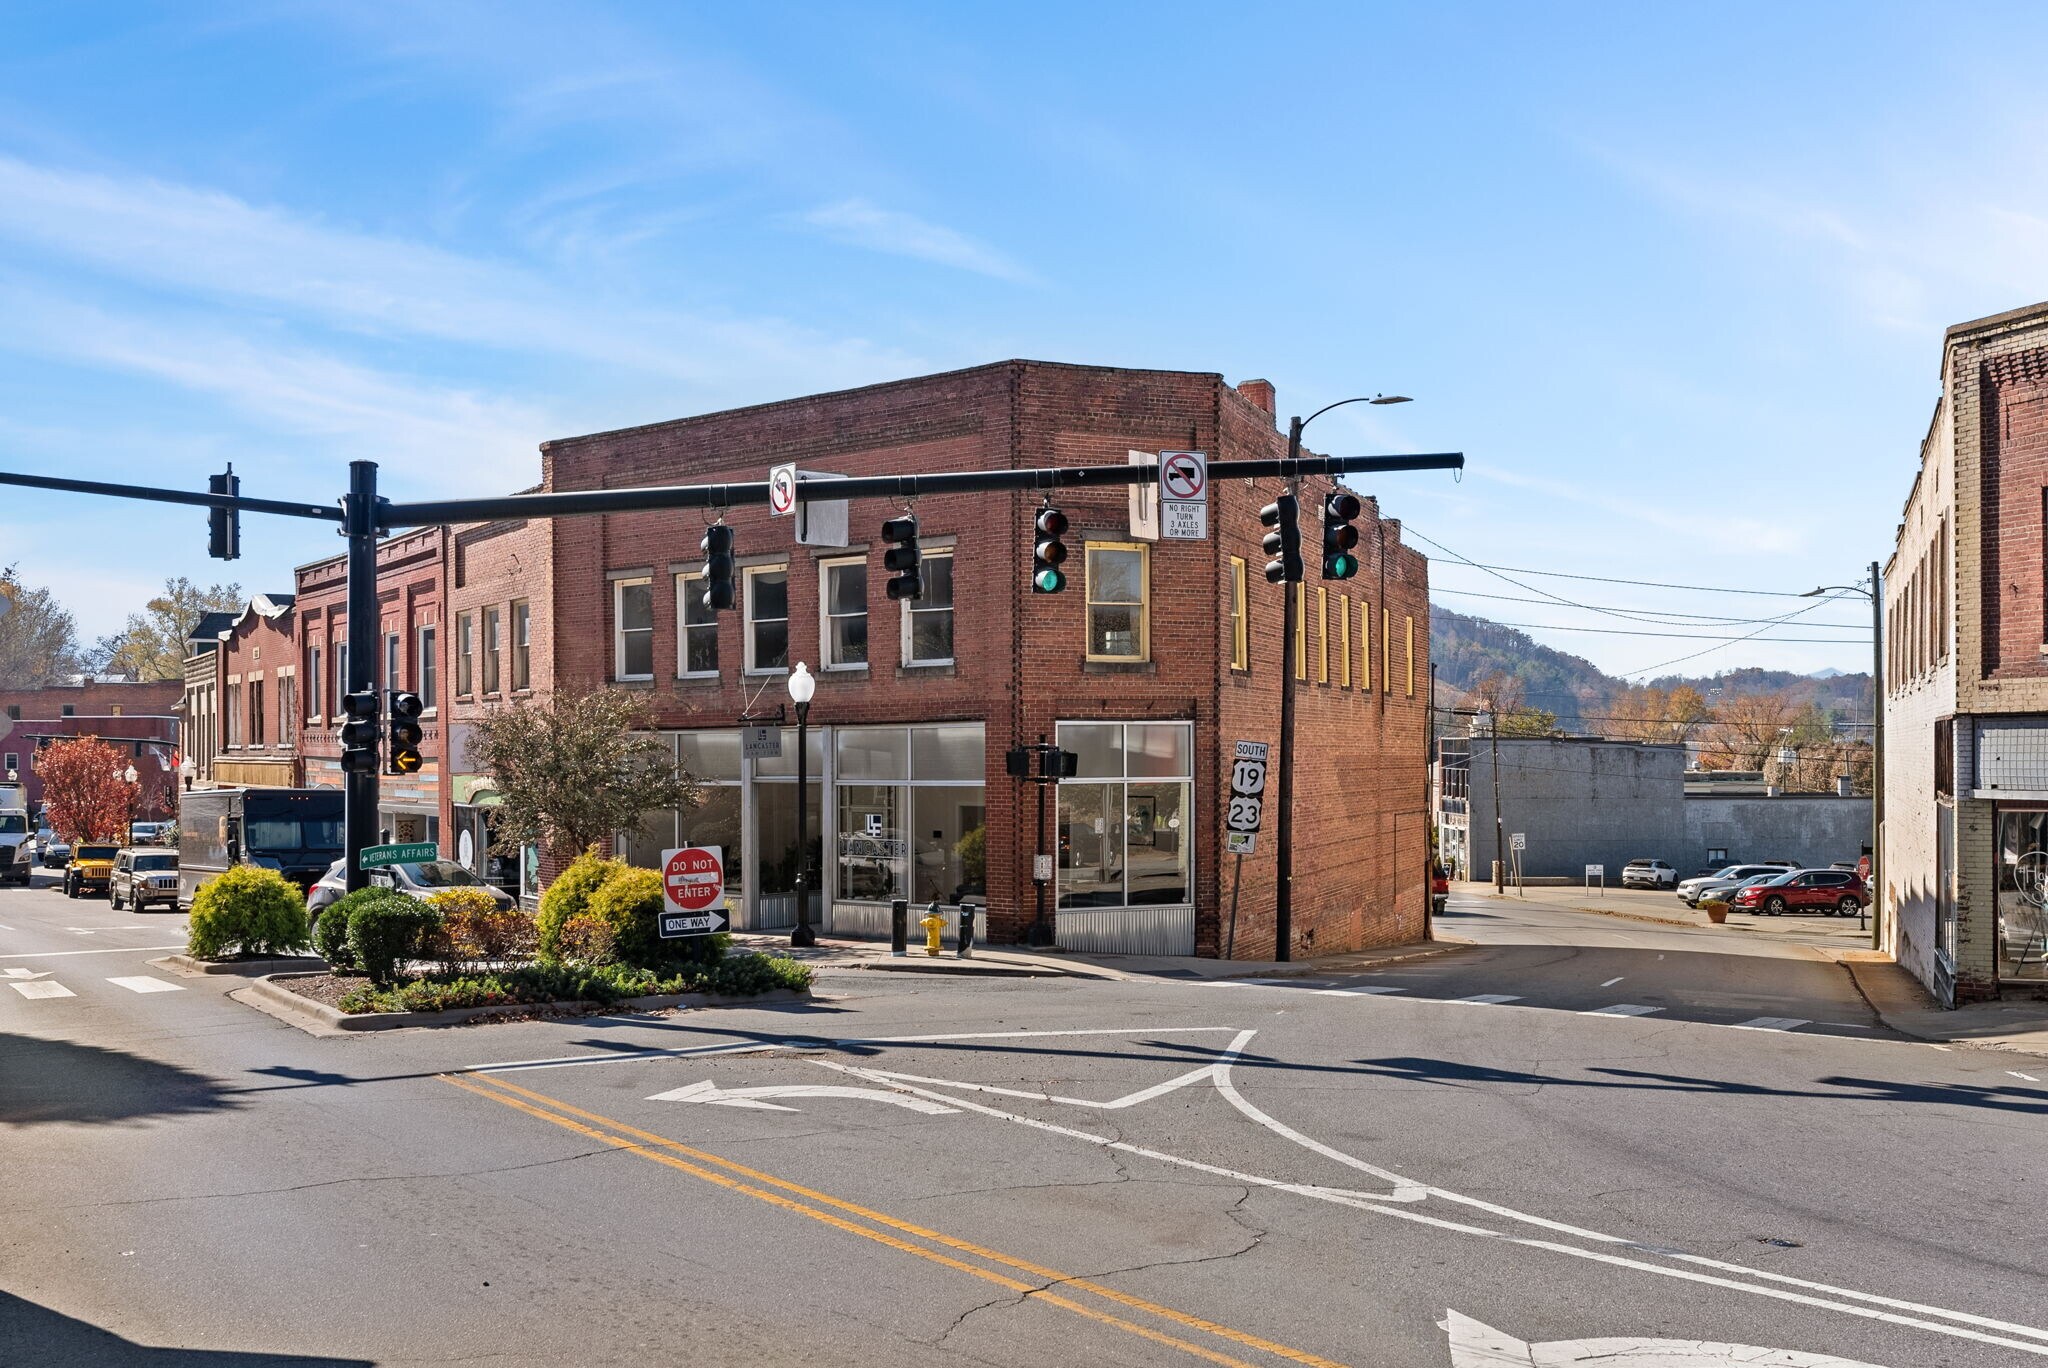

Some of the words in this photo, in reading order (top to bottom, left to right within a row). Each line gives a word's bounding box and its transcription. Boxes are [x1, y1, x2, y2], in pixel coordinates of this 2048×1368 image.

[1176, 512, 1193, 520] TURN
[1170, 520, 1175, 528] 3
[1177, 521, 1199, 529] AXLES
[1169, 528, 1179, 536] OR
[1181, 529, 1200, 537] MORE
[745, 742, 780, 750] LANCASTER
[1237, 744, 1266, 757] SOUTH
[1240, 767, 1259, 787] 19
[1230, 804, 1258, 824] 23
[369, 849, 398, 863] VETERANS
[401, 847, 435, 859] AFFAIRS
[840, 840, 908, 857] LANCASTER
[672, 861, 687, 872] DO
[693, 859, 713, 870] NOT
[678, 886, 711, 899] ENTER
[668, 919, 687, 930] ONE
[691, 917, 709, 928] WAY
